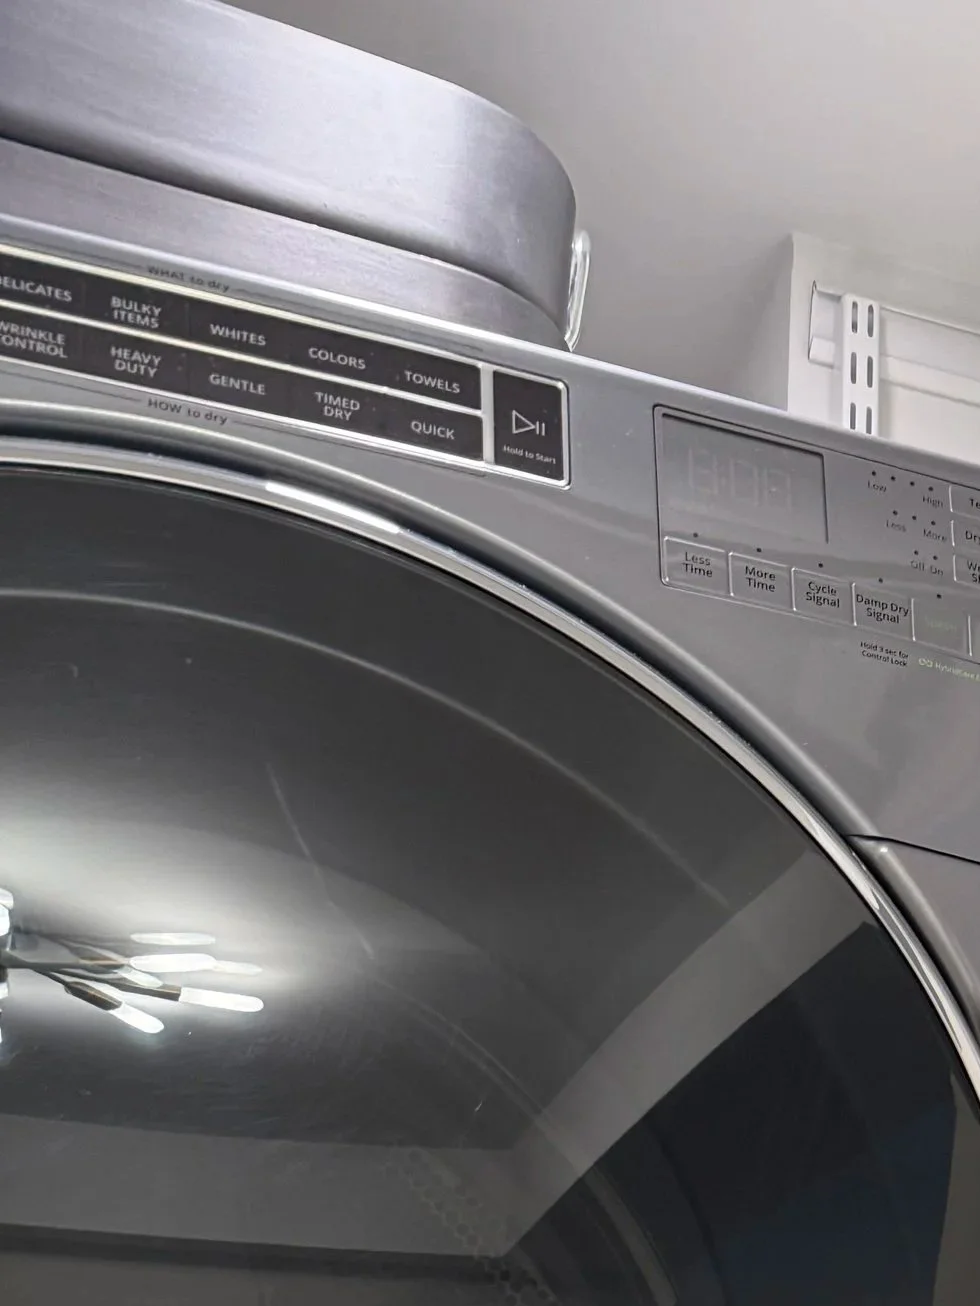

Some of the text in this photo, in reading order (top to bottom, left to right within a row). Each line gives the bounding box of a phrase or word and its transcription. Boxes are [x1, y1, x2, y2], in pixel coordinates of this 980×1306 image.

[148, 265, 230, 293] WHAT to dry
[110, 295, 162, 316] BULKY
[112, 309, 160, 330] ITEMS
[209, 323, 267, 347] WHITES
[110, 346, 162, 368] HEAVY
[307, 346, 367, 371] COLORS
[114, 360, 158, 379] DUTY
[209, 373, 267, 396] GENTLE
[403, 370, 461, 394] TOWELS
[314, 391, 361, 412] TIMED
[147, 398, 230, 428] HOW to dry
[323, 405, 352, 422] DRY
[410, 419, 456, 441] QUICK
[502, 443, 557, 465] Hold to Start
[867, 480, 887, 493] Low
[922, 495, 945, 510] High
[886, 518, 907, 533] Less
[923, 528, 948, 543] More
[684, 551, 711, 567] Less
[682, 562, 714, 579] Time
[744, 565, 777, 582] More
[929, 563, 944, 577] On
[745, 577, 777, 594] Time
[807, 580, 838, 597] Cycle
[805, 591, 841, 609] Signal
[855, 593, 910, 617] Damp Dry
[865, 607, 901, 624] Signal
[860, 641, 878, 652] Hold
[861, 650, 908, 667] Control Lock
